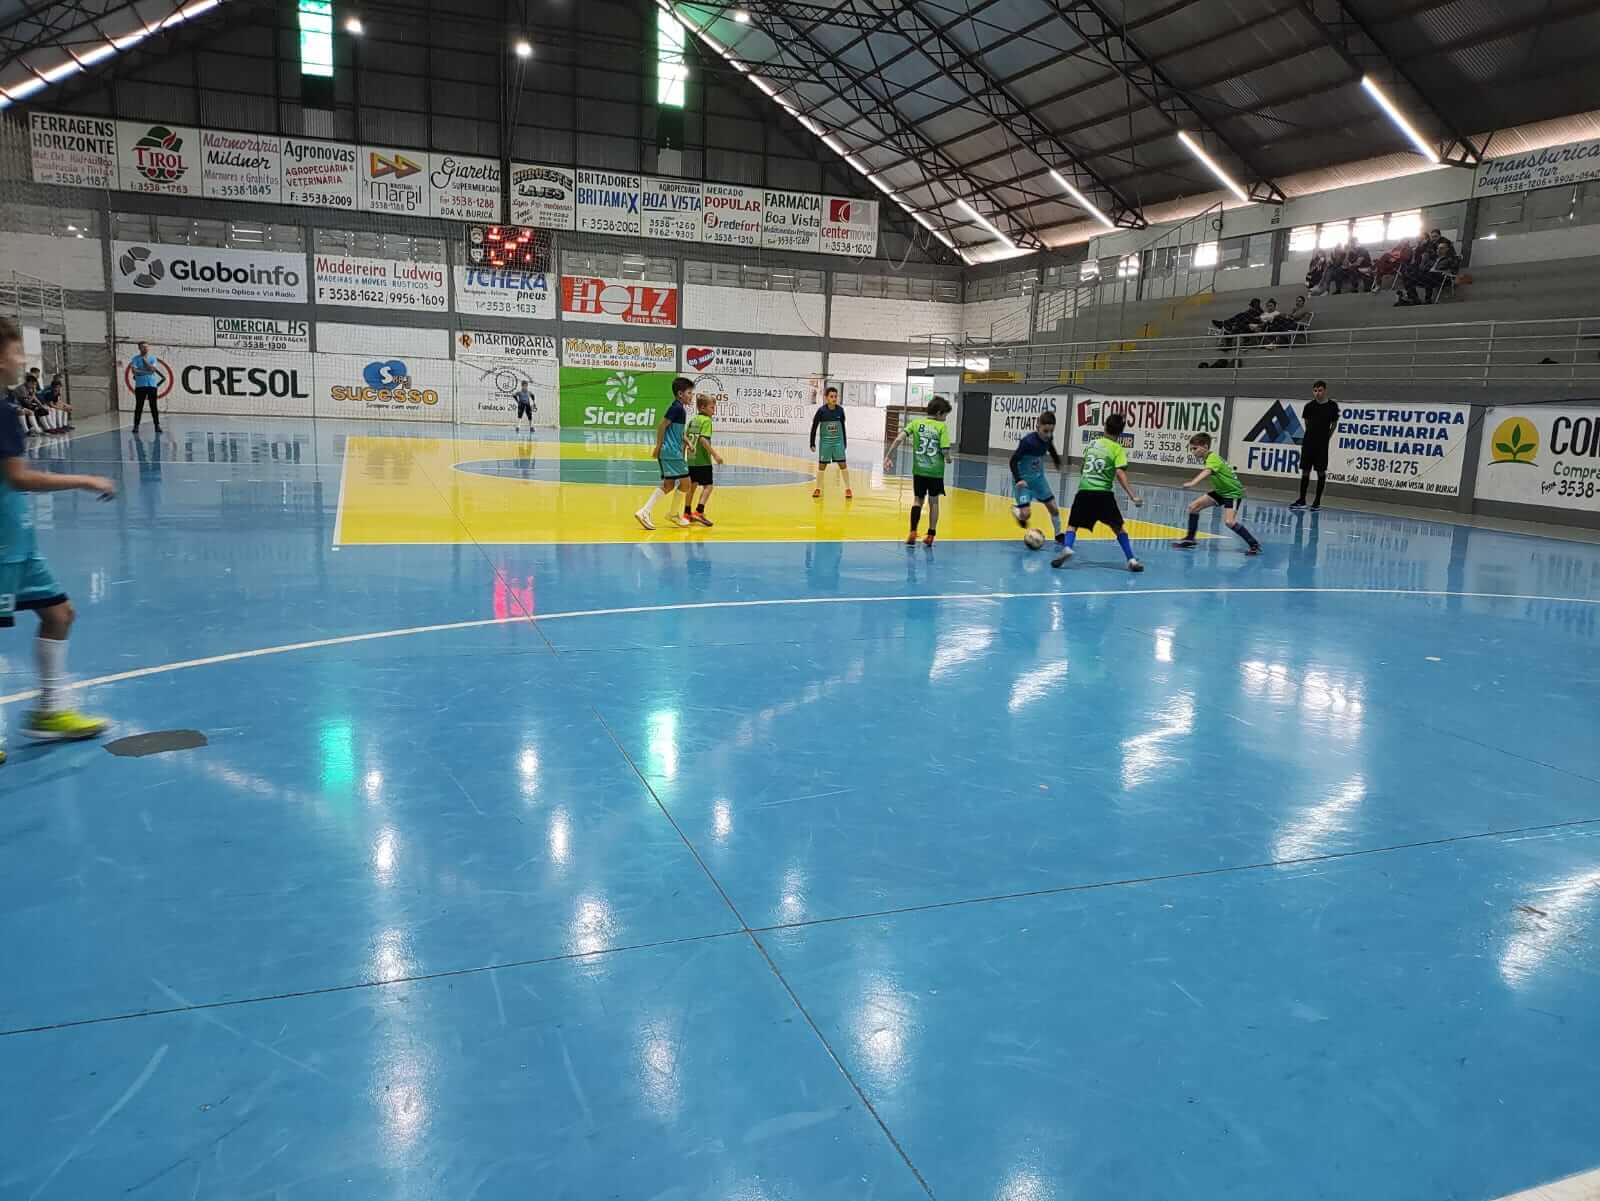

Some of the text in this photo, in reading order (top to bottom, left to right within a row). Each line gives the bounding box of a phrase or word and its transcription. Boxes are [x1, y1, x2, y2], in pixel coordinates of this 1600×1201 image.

[31, 115, 114, 137] FERRAGENS
[32, 132, 116, 155] HORIZONTE
[202, 133, 281, 154] Marmoraria
[283, 140, 356, 163] Agronovas
[131, 147, 189, 170] TIROL
[207, 150, 272, 170] Mildner
[430, 156, 500, 189] Giaretta
[577, 171, 640, 189] BRITADORES
[301, 192, 352, 207] 3538-2009
[518, 183, 566, 201] LAJES
[706, 186, 744, 197] MERCADO
[577, 187, 640, 215] BRITAMAX
[642, 192, 702, 212] BOA VISTA
[704, 196, 761, 213] POPULAR
[590, 218, 640, 233] 3538-2002
[649, 219, 696, 231] 3538-1260
[718, 219, 761, 233] redefort
[765, 210, 820, 228] Boa Vista
[170, 259, 300, 287] Globoinfo
[316, 257, 443, 287] Madeireira Ludwig
[317, 275, 353, 284] MADEIRAS
[466, 267, 548, 291] TCHEKA
[181, 285, 210, 293] Internet
[211, 287, 230, 295] Fibra
[319, 287, 325, 298] F
[516, 291, 547, 302] pneus
[571, 278, 669, 318] HOLZ
[216, 319, 307, 335] COMERCIAL HS
[474, 333, 554, 348] MARMORARIA
[616, 340, 641, 356] Boa
[644, 343, 675, 358] Vista
[721, 349, 752, 357] MERCADO
[181, 365, 309, 399] CRESOL
[331, 385, 438, 405] sucesso
[994, 397, 1057, 413] ESQUADRIAS
[583, 406, 657, 426] Sicredi
[1338, 423, 1449, 440] ENGENHARIA
[916, 436, 938, 457] 35
[1143, 440, 1155, 449] 55
[1158, 441, 1182, 451] 3538
[1355, 457, 1419, 475] 3538-1275
[1408, 482, 1425, 490] VISTA
